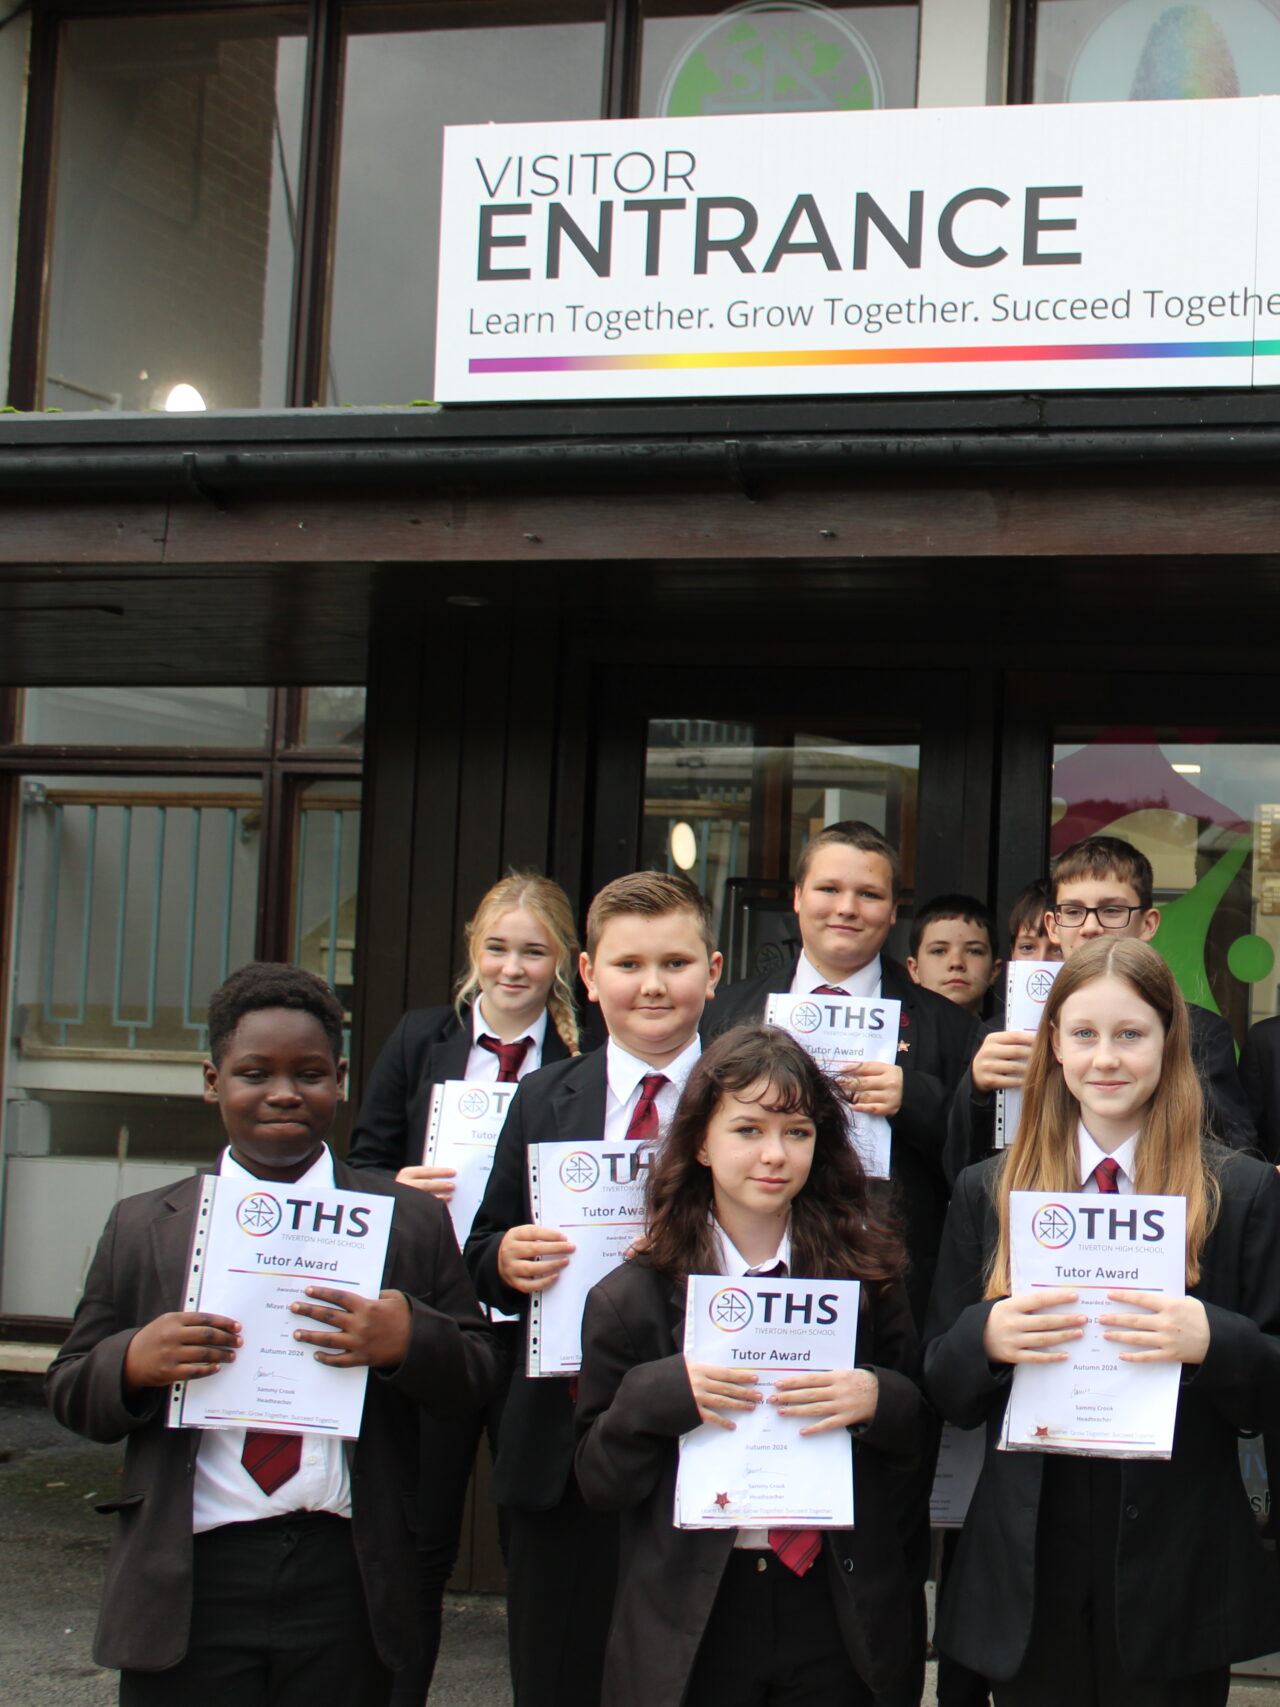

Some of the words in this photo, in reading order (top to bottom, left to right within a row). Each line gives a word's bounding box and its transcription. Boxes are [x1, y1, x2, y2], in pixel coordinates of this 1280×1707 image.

[475, 150, 697, 198] VISITOR
[476, 186, 1083, 281] ENTRANCE
[468, 306, 556, 337] Learn
[566, 301, 716, 341] Together.
[727, 298, 814, 330] Grow
[824, 294, 979, 334] Together.
[992, 290, 1132, 324] Succeed
[825, 1005, 885, 1030] THS
[805, 1045, 831, 1054] Tutor
[834, 1047, 864, 1056] Award
[602, 1153, 656, 1182] TH
[286, 1199, 371, 1237] THS
[582, 1206, 615, 1217] Tutor
[1079, 1207, 1165, 1242] THS
[1078, 1244, 1113, 1252] TIVERTON
[1135, 1246, 1164, 1254] SCHOOL
[256, 1253, 291, 1266] Tutor
[294, 1257, 338, 1272] Award
[1055, 1266, 1092, 1278] Tutor
[1095, 1267, 1139, 1280] Award
[757, 1292, 839, 1325] THS
[755, 1327, 788, 1335] TIVERTON
[732, 1348, 766, 1361] Tutor
[769, 1349, 811, 1361] Award
[1073, 1364, 1101, 1372] Autumn
